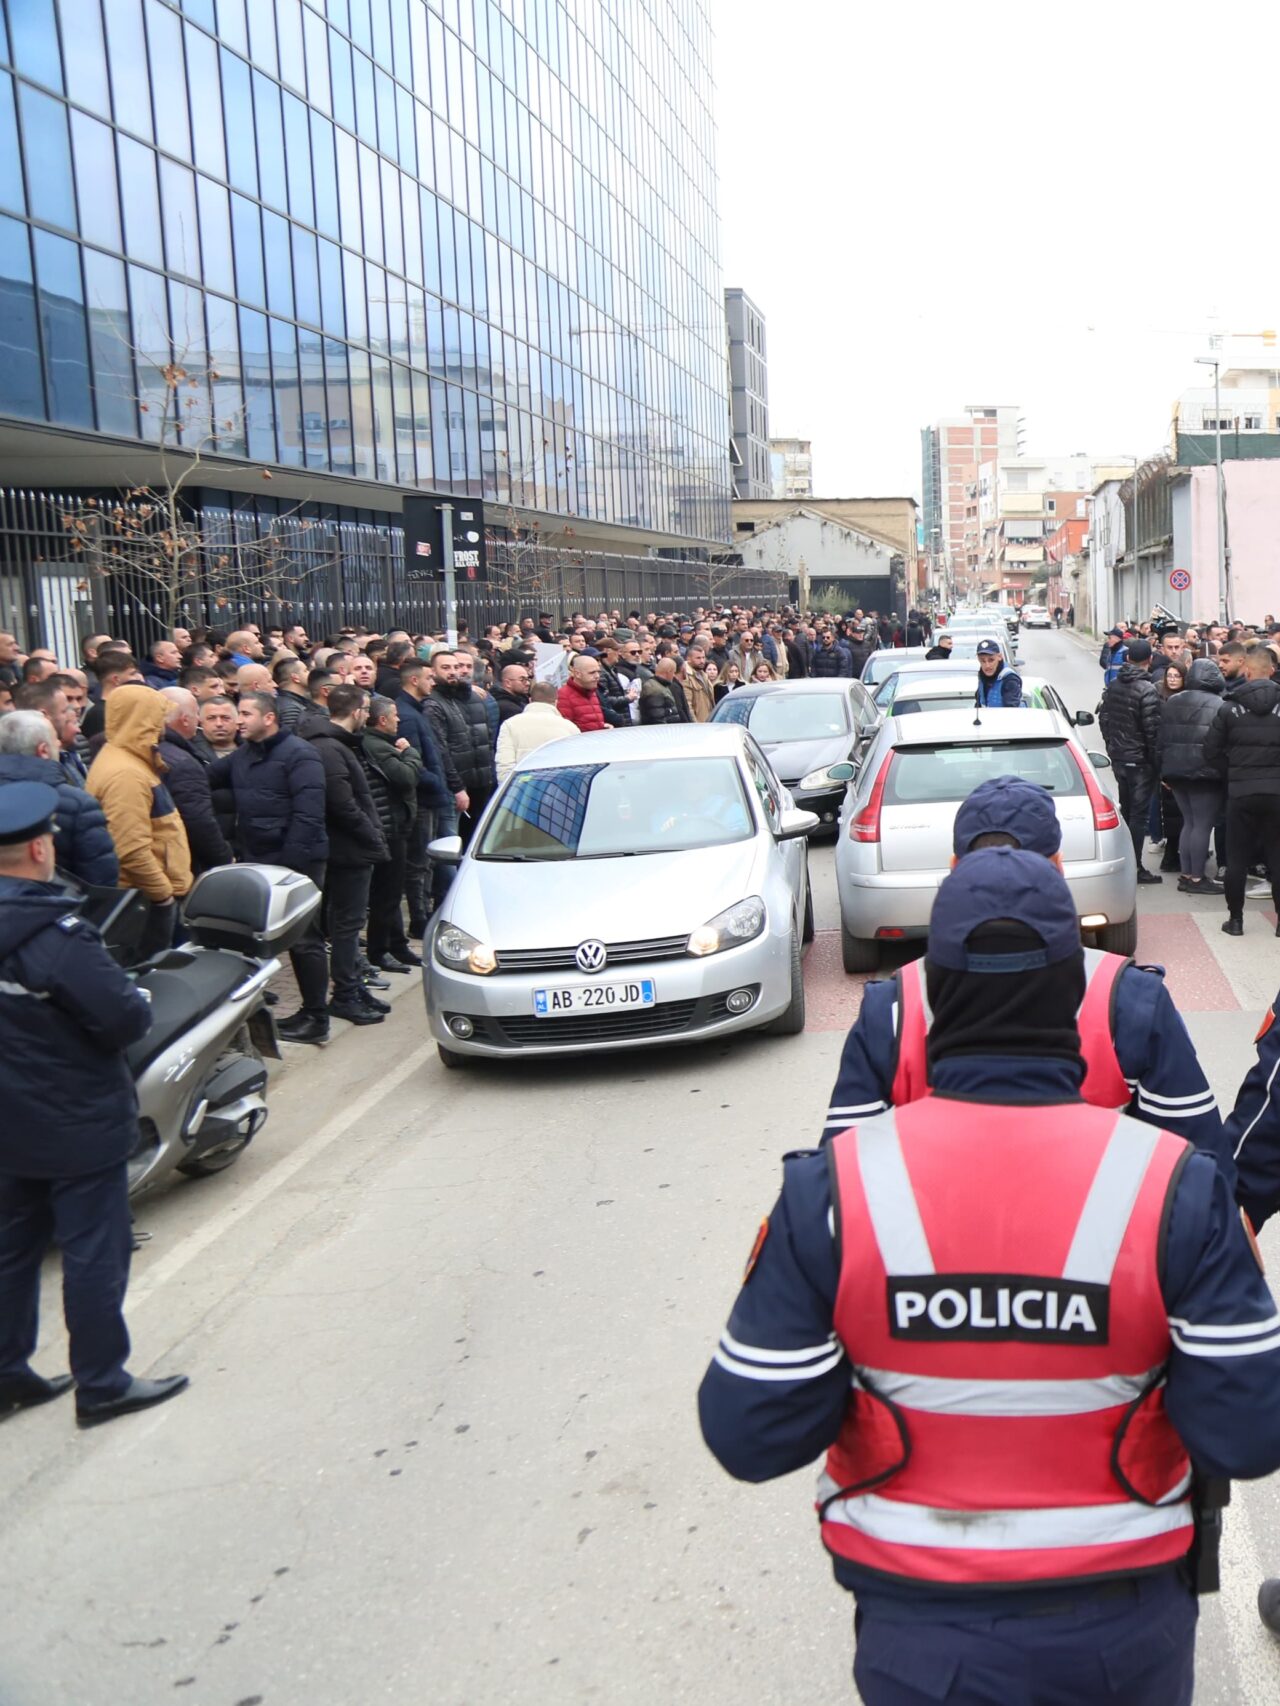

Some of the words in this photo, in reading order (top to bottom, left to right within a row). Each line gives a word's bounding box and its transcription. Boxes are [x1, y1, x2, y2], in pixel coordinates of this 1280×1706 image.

[454, 550, 479, 562] FROST
[552, 991, 573, 1010] AB
[583, 987, 615, 1007] 220
[619, 984, 640, 1004] JD
[894, 1287, 1097, 1332] POLICIA
